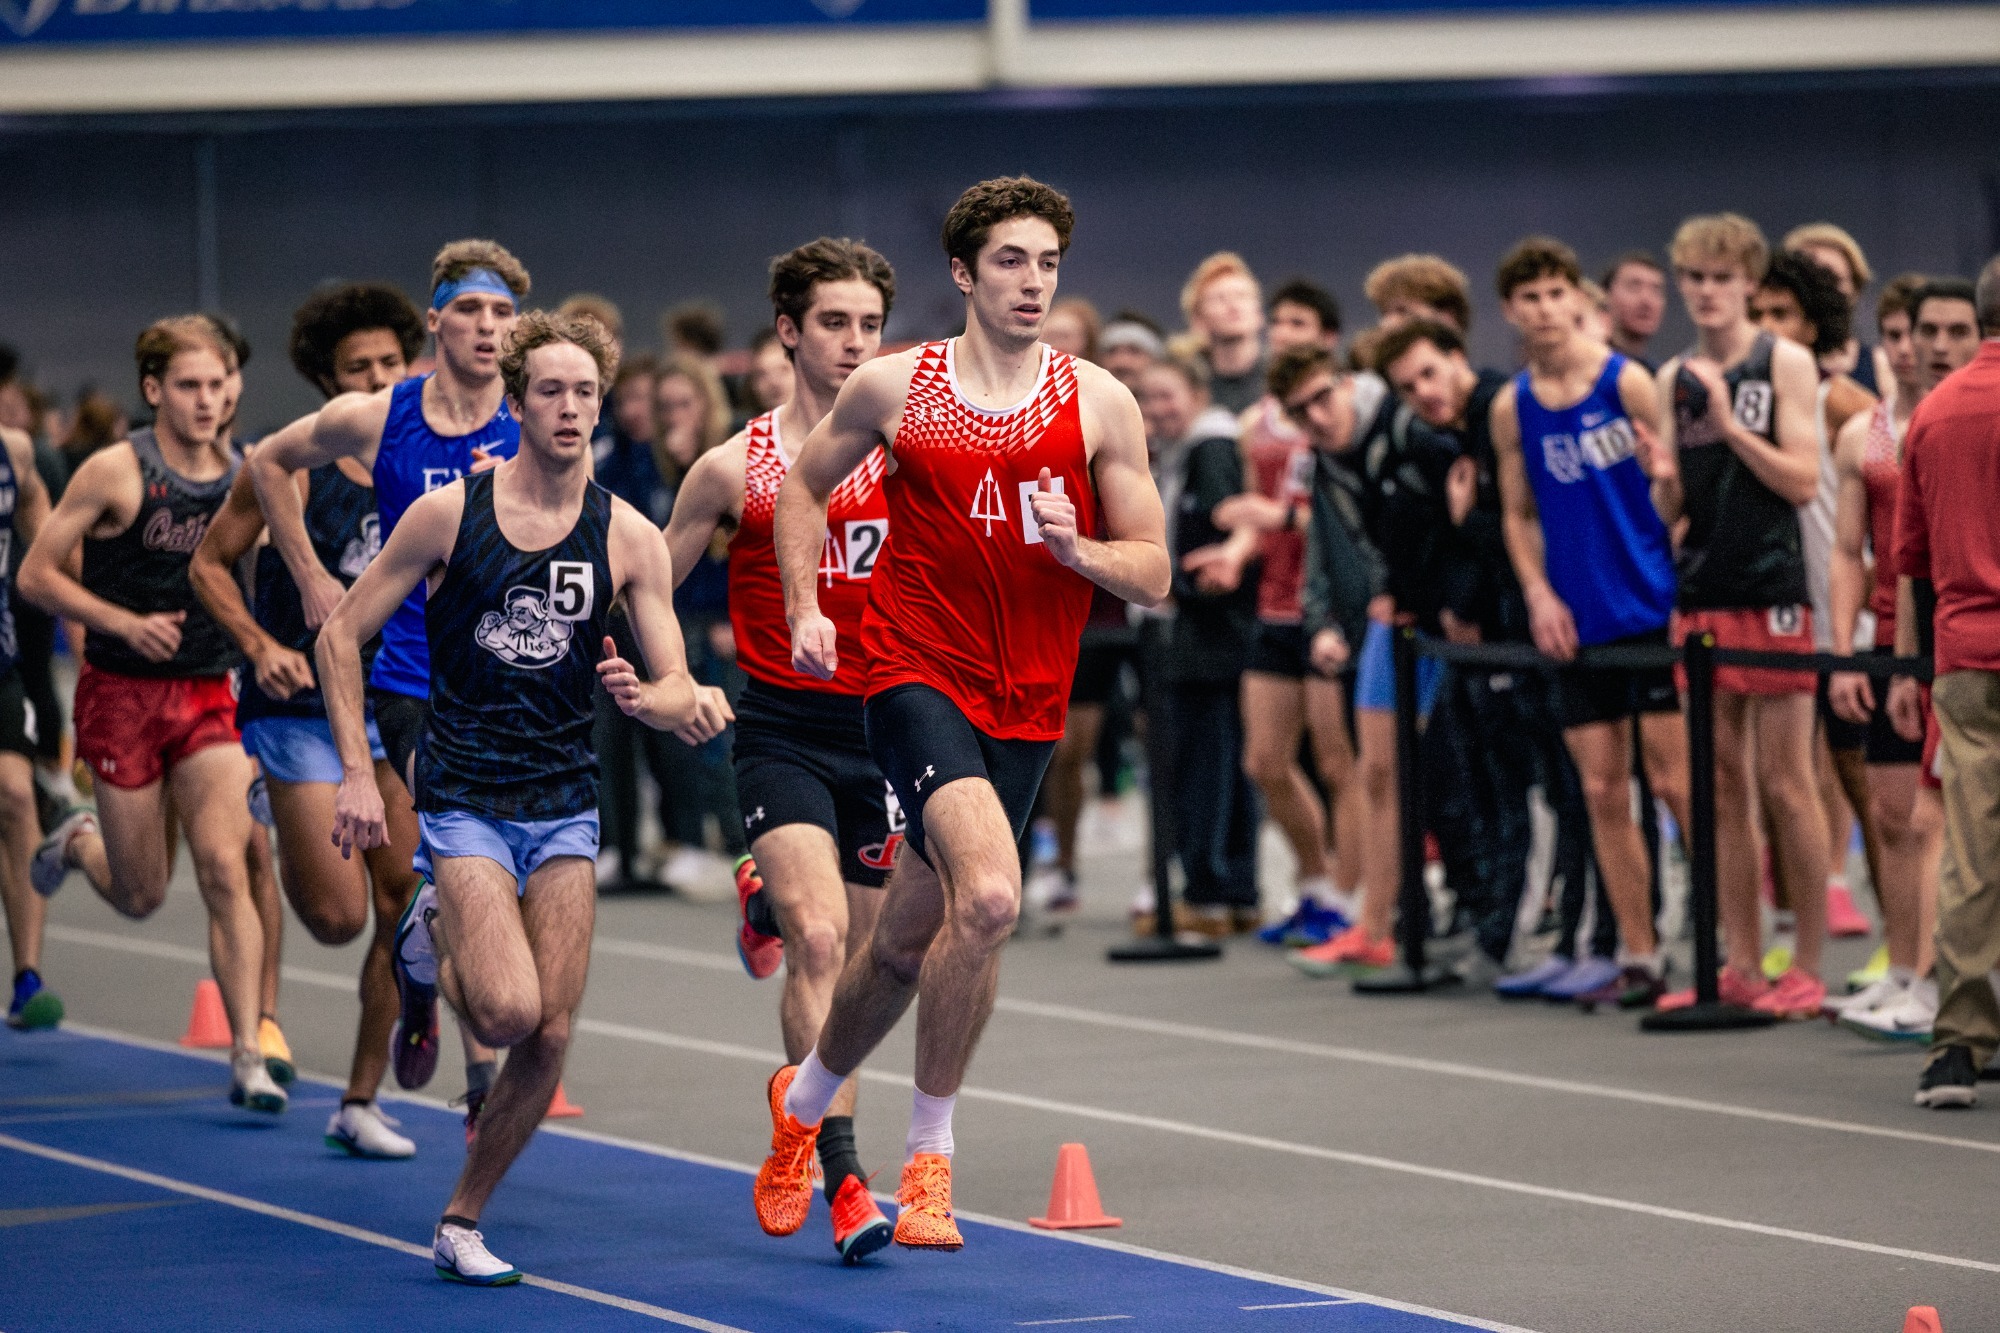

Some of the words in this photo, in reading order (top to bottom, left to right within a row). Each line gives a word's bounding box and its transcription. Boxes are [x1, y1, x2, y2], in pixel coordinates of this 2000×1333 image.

[1742, 388, 1761, 426] 8
[851, 525, 881, 573] 2
[553, 566, 585, 617] 5
